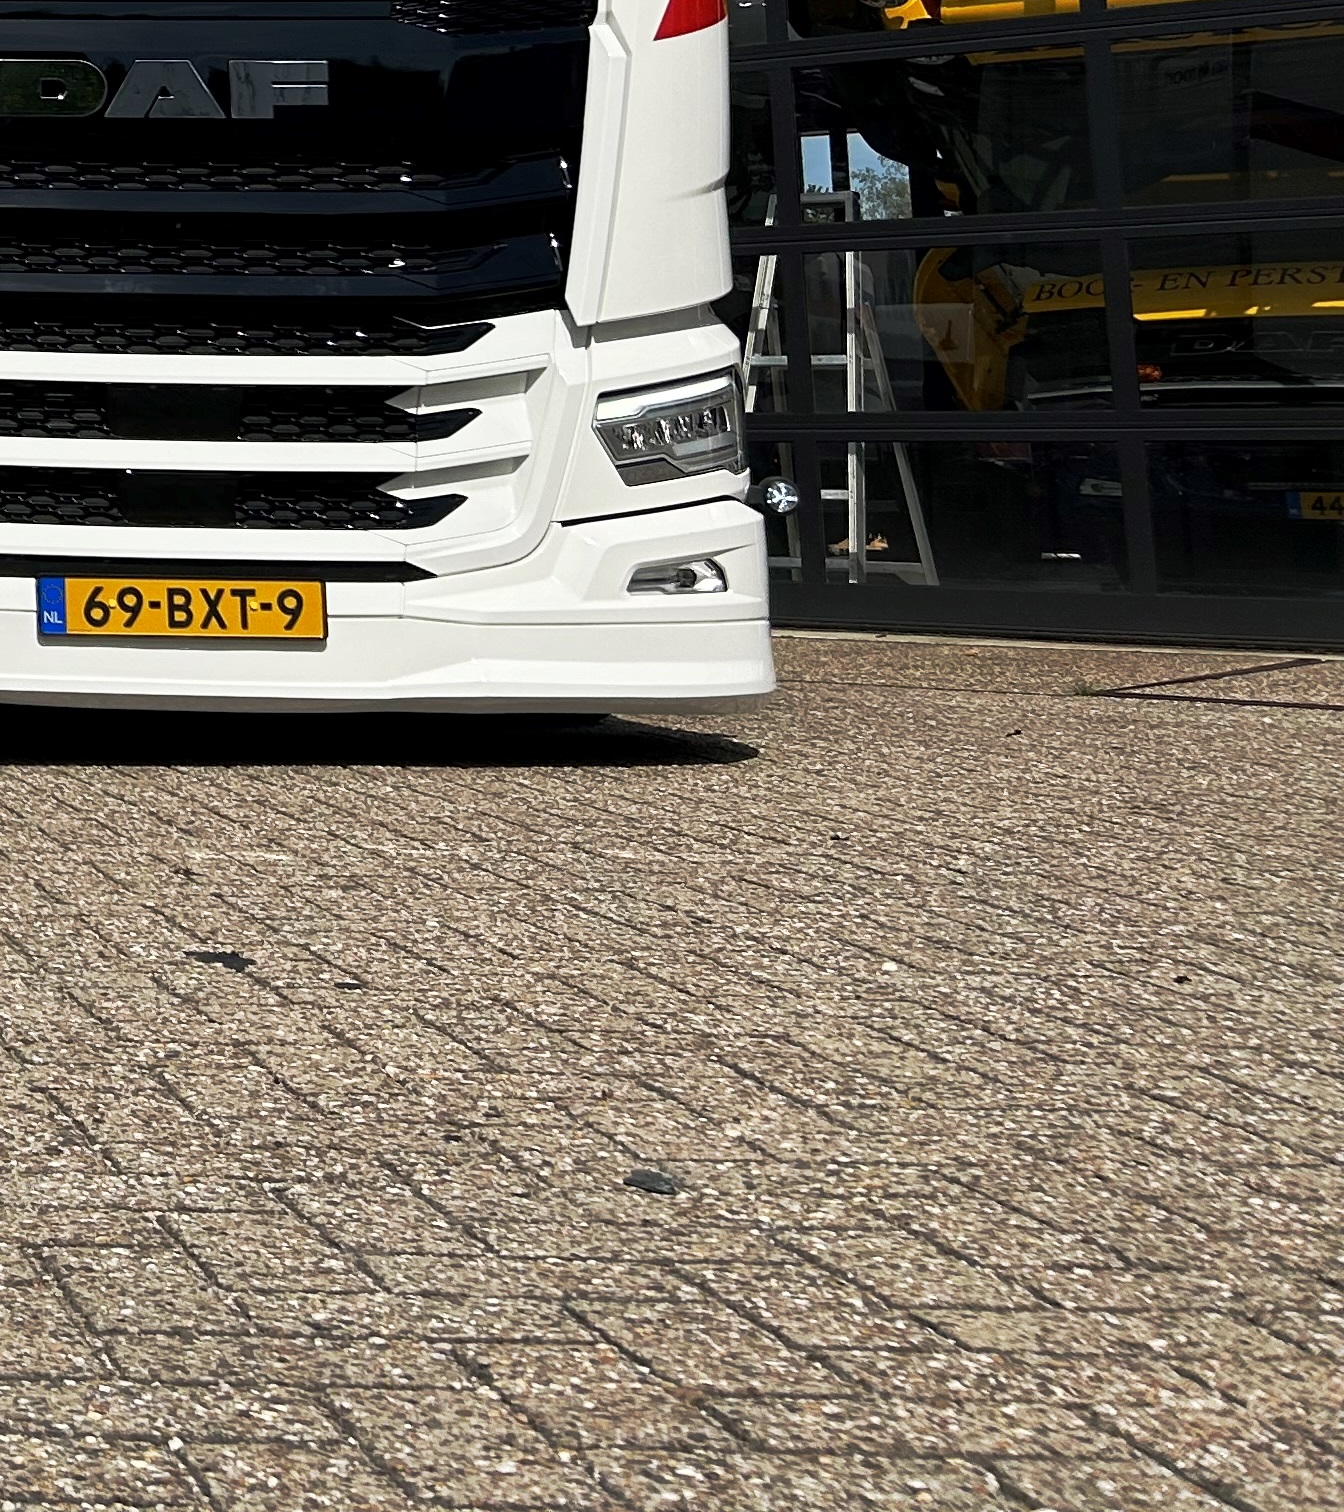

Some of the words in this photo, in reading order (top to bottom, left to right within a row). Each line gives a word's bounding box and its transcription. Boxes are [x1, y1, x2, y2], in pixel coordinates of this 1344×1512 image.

[1156, 271, 1215, 292] EN
[43, 610, 63, 624] NL
[82, 585, 304, 631] 69-BXT-9
